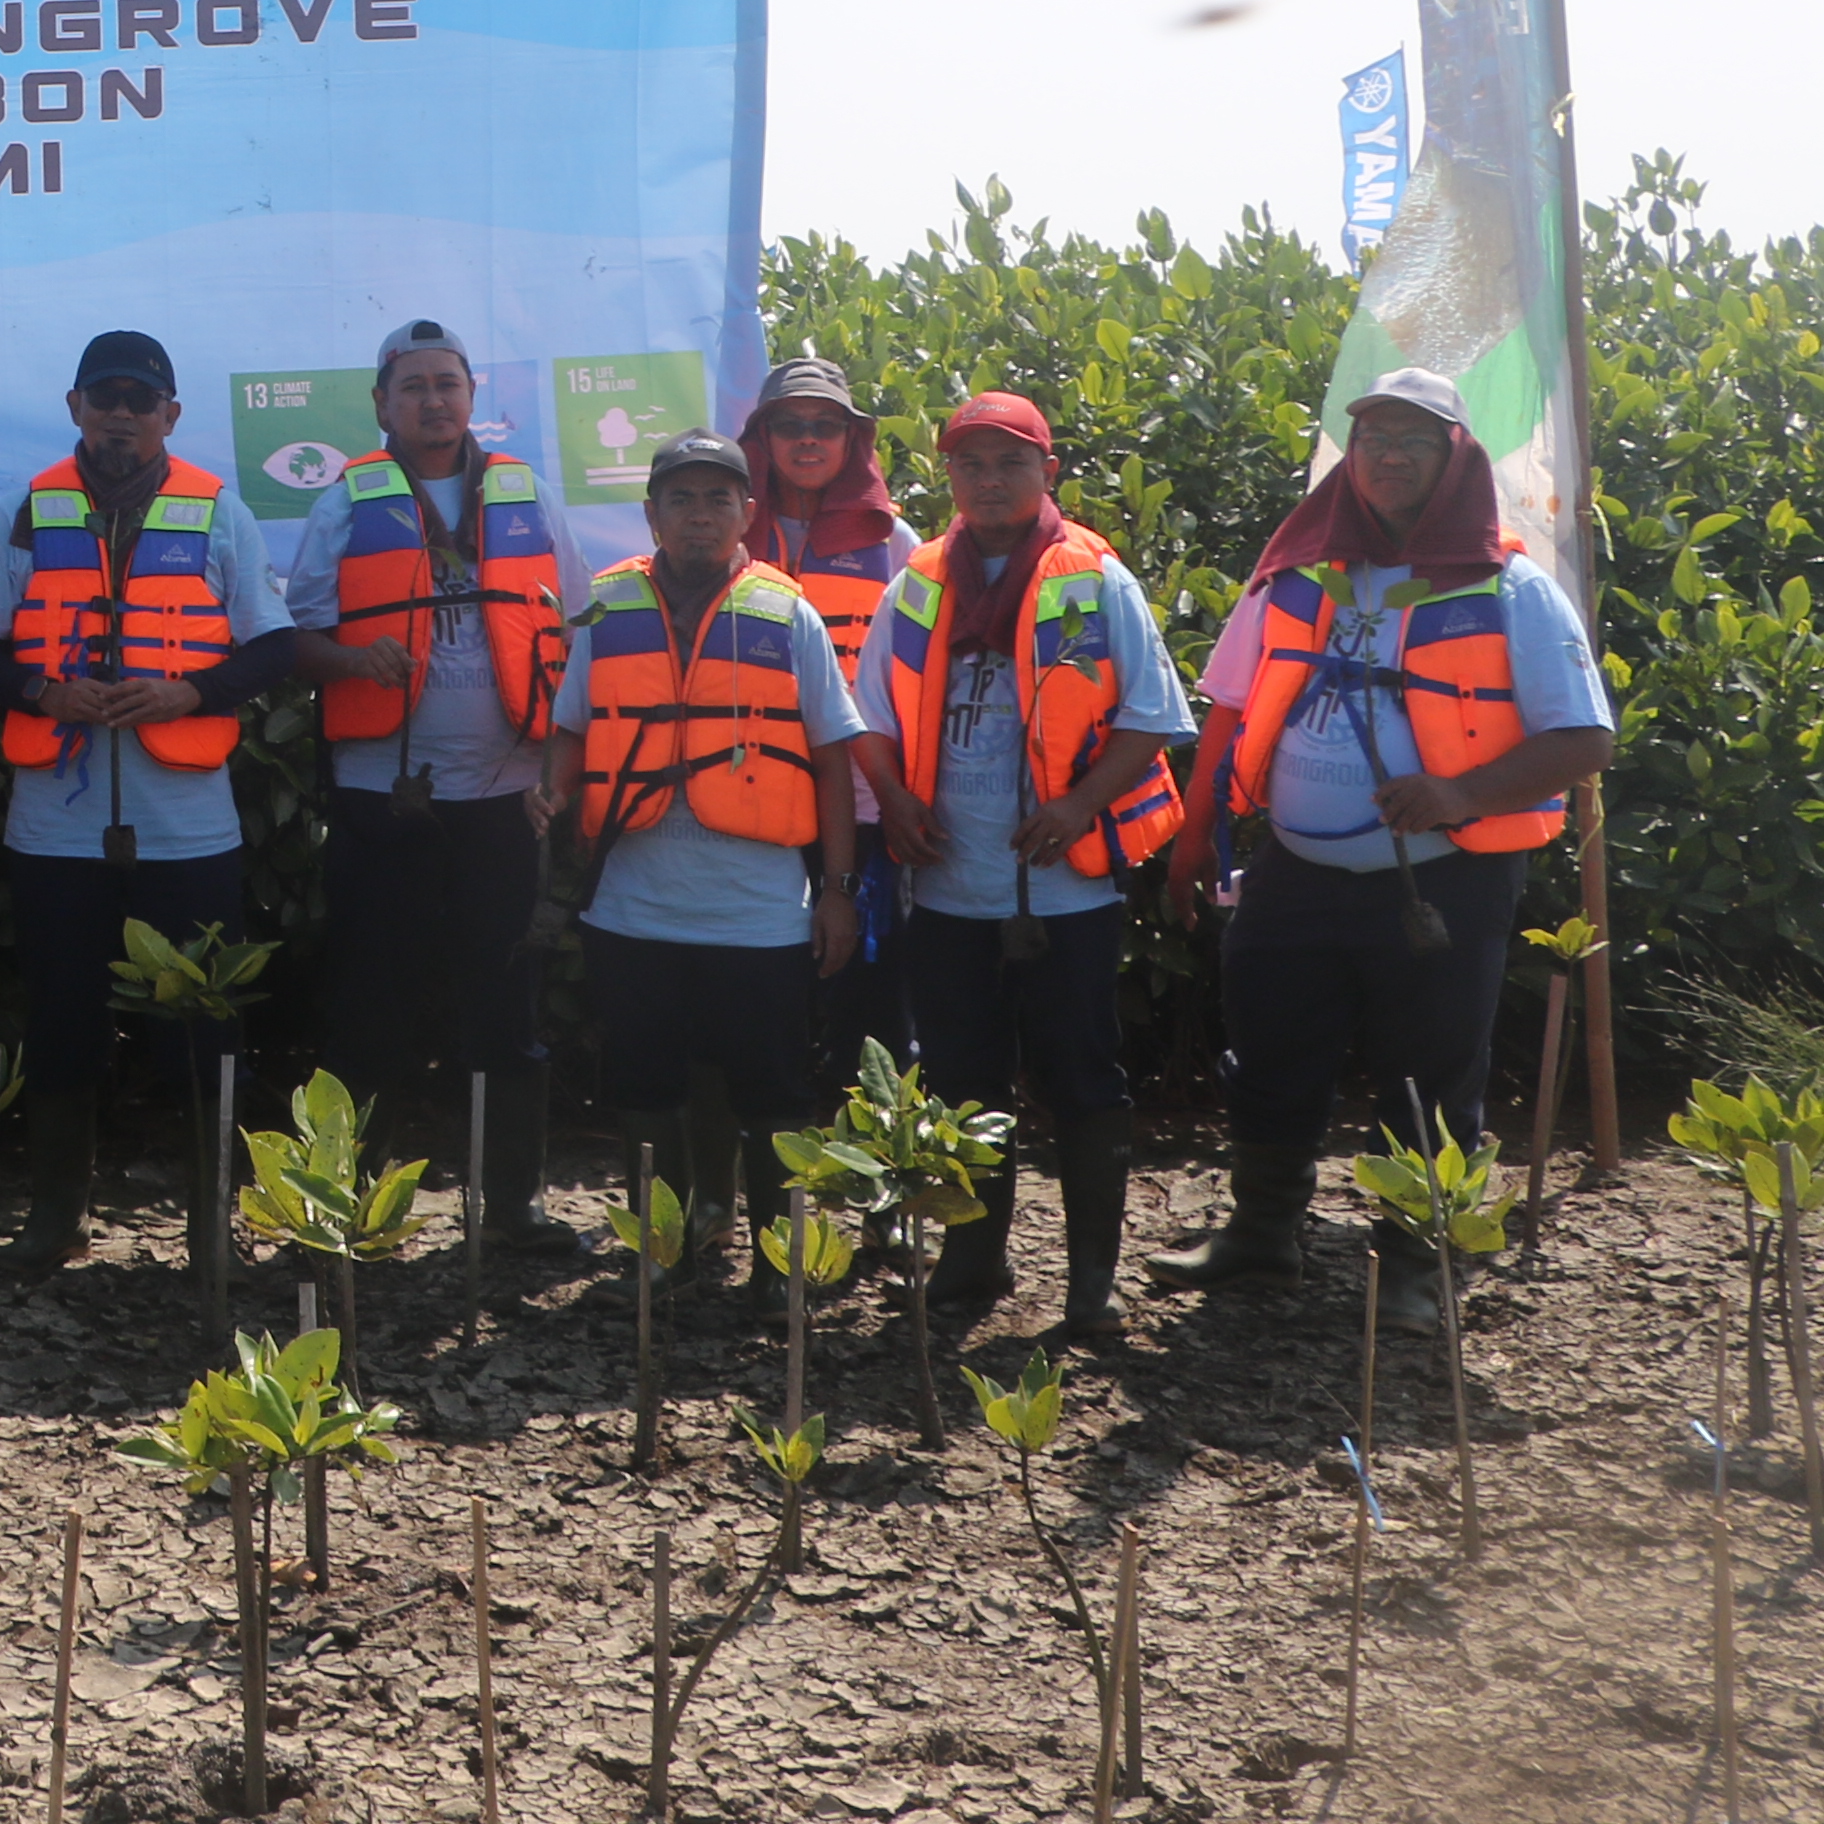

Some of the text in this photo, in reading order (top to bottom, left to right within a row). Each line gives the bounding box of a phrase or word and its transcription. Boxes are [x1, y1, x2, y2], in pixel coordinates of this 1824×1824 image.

[566, 365, 616, 394] 15 LIFE
[596, 377, 638, 393] ON LAND
[243, 380, 313, 409] 13 CLIMATE
[273, 394, 307, 408] ACTION
